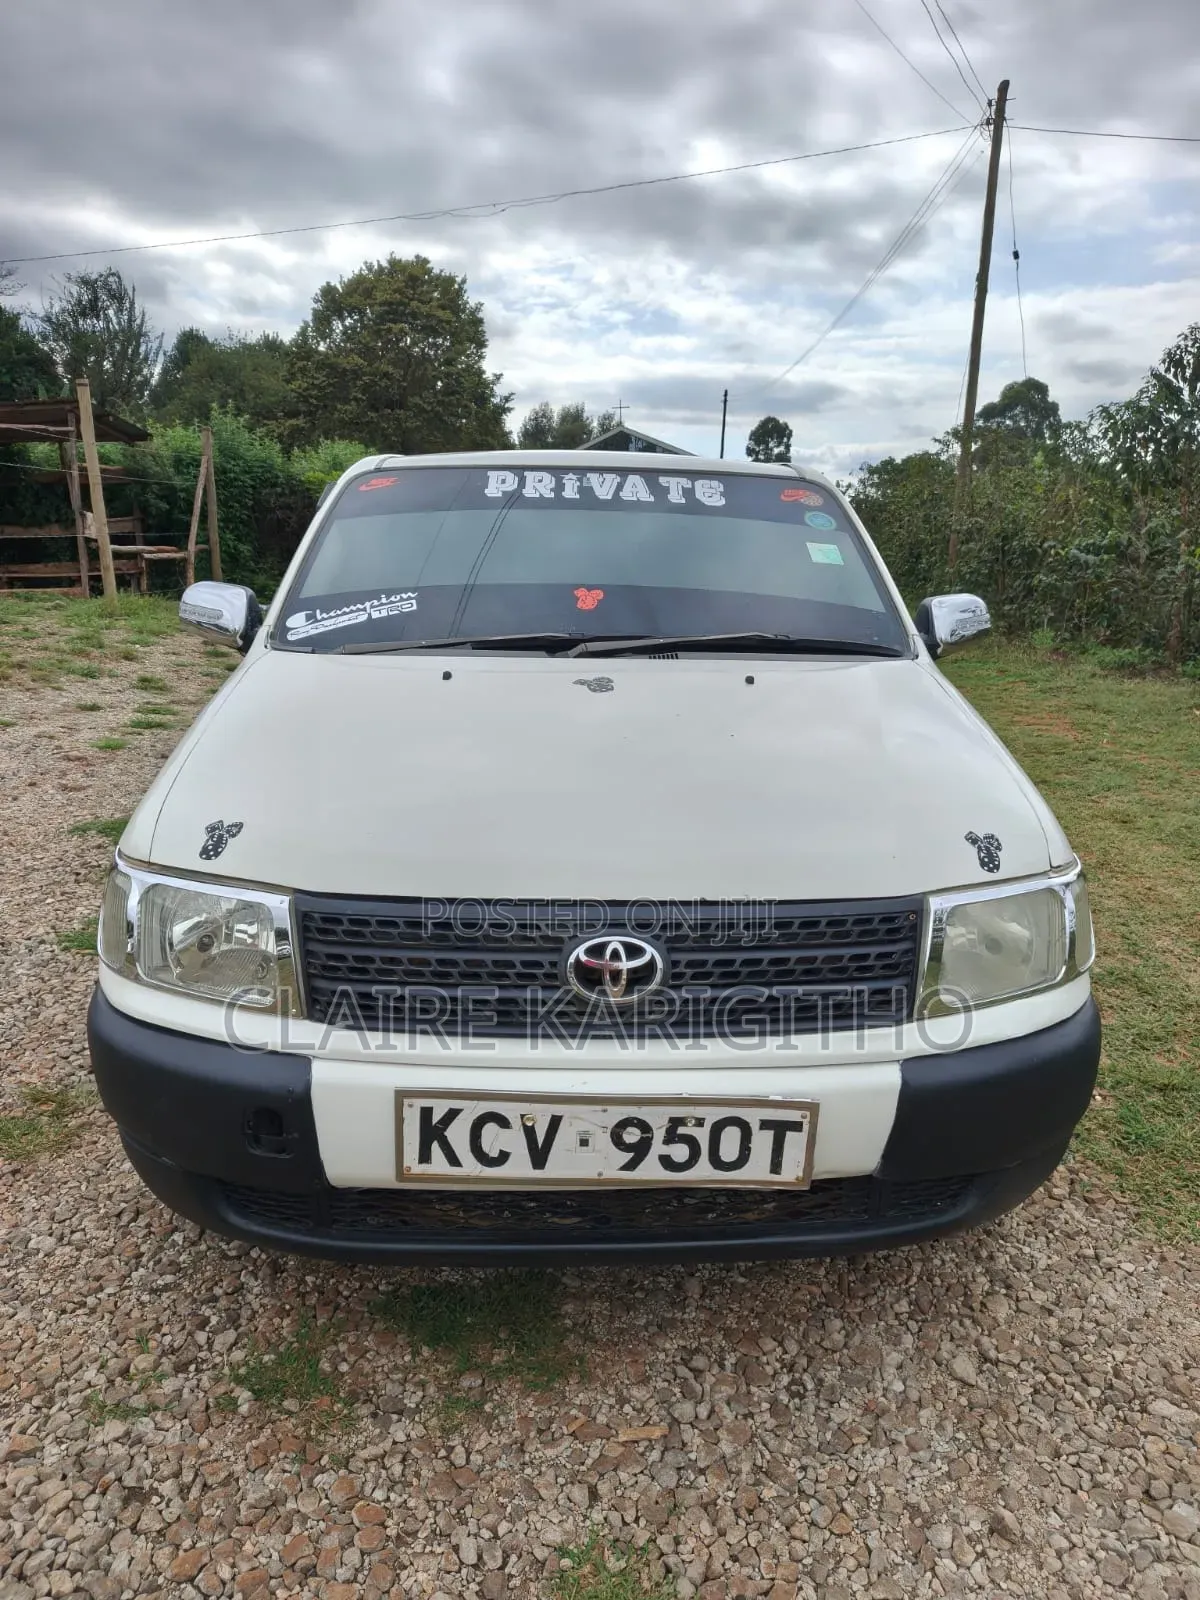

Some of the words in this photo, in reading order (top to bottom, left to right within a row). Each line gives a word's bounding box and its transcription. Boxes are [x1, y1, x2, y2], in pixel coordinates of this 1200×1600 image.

[285, 591, 419, 628] Champion
[417, 1106, 564, 1170] KCV
[609, 1115, 804, 1175] 950T
